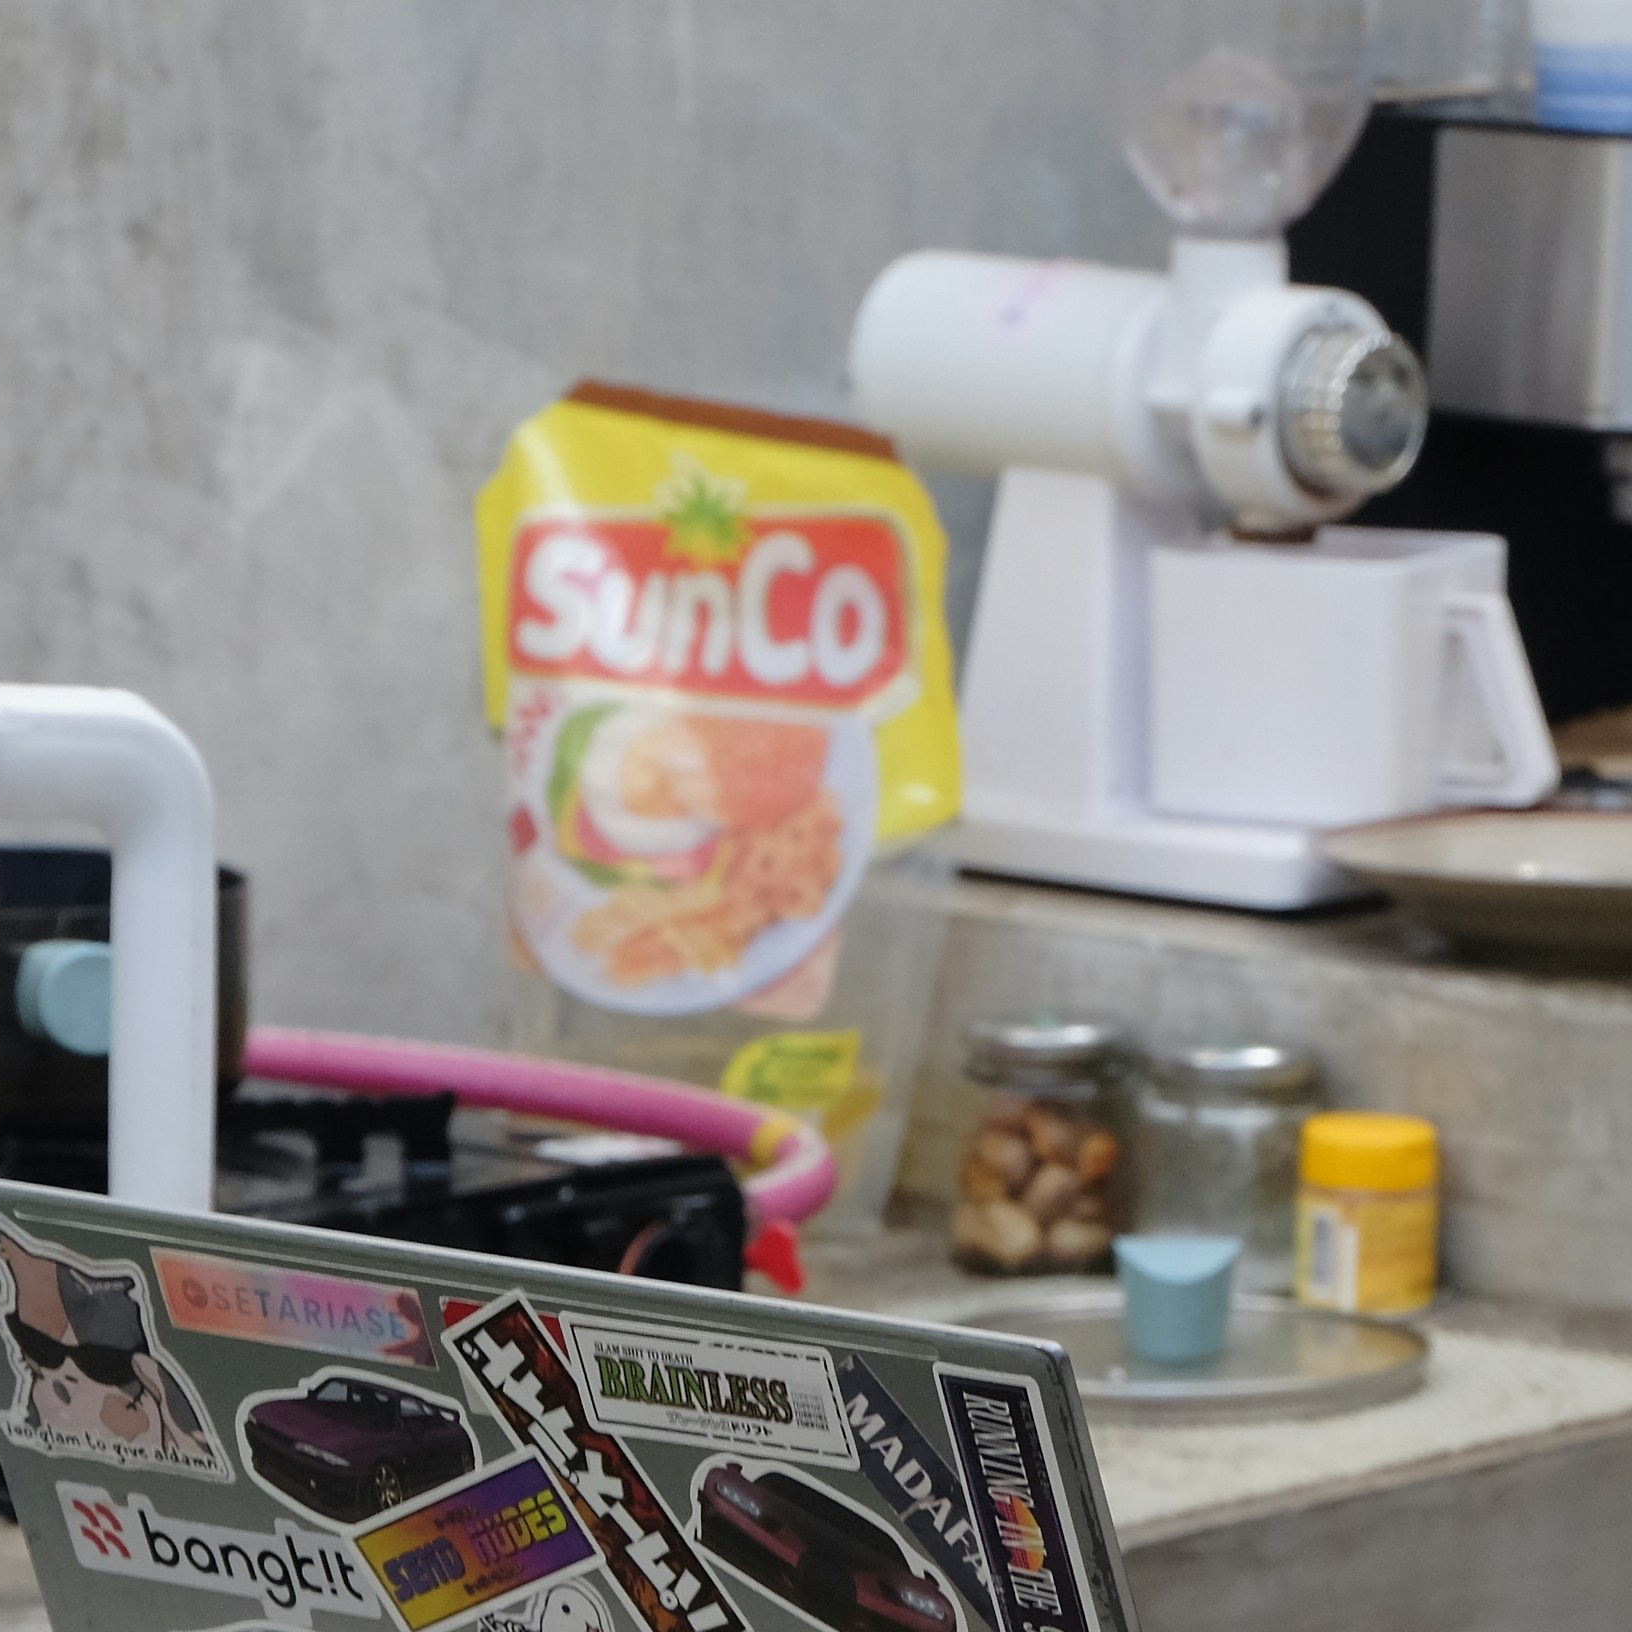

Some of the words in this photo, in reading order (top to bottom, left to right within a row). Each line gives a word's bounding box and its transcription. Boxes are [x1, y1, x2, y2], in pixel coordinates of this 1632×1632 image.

[516, 530, 886, 688] SunCo
[647, 1349, 659, 1361] TO
[661, 1351, 694, 1366] DEATH
[594, 1355, 793, 1424] BRAINLESS
[40, 1424, 82, 1450] glam
[84, 1430, 107, 1450] to
[112, 1443, 147, 1464] give
[964, 1392, 1034, 1508] RUNNING
[467, 1489, 568, 1566] NUDES
[996, 1516, 1047, 1557] IN
[1008, 1562, 1062, 1616] THE
